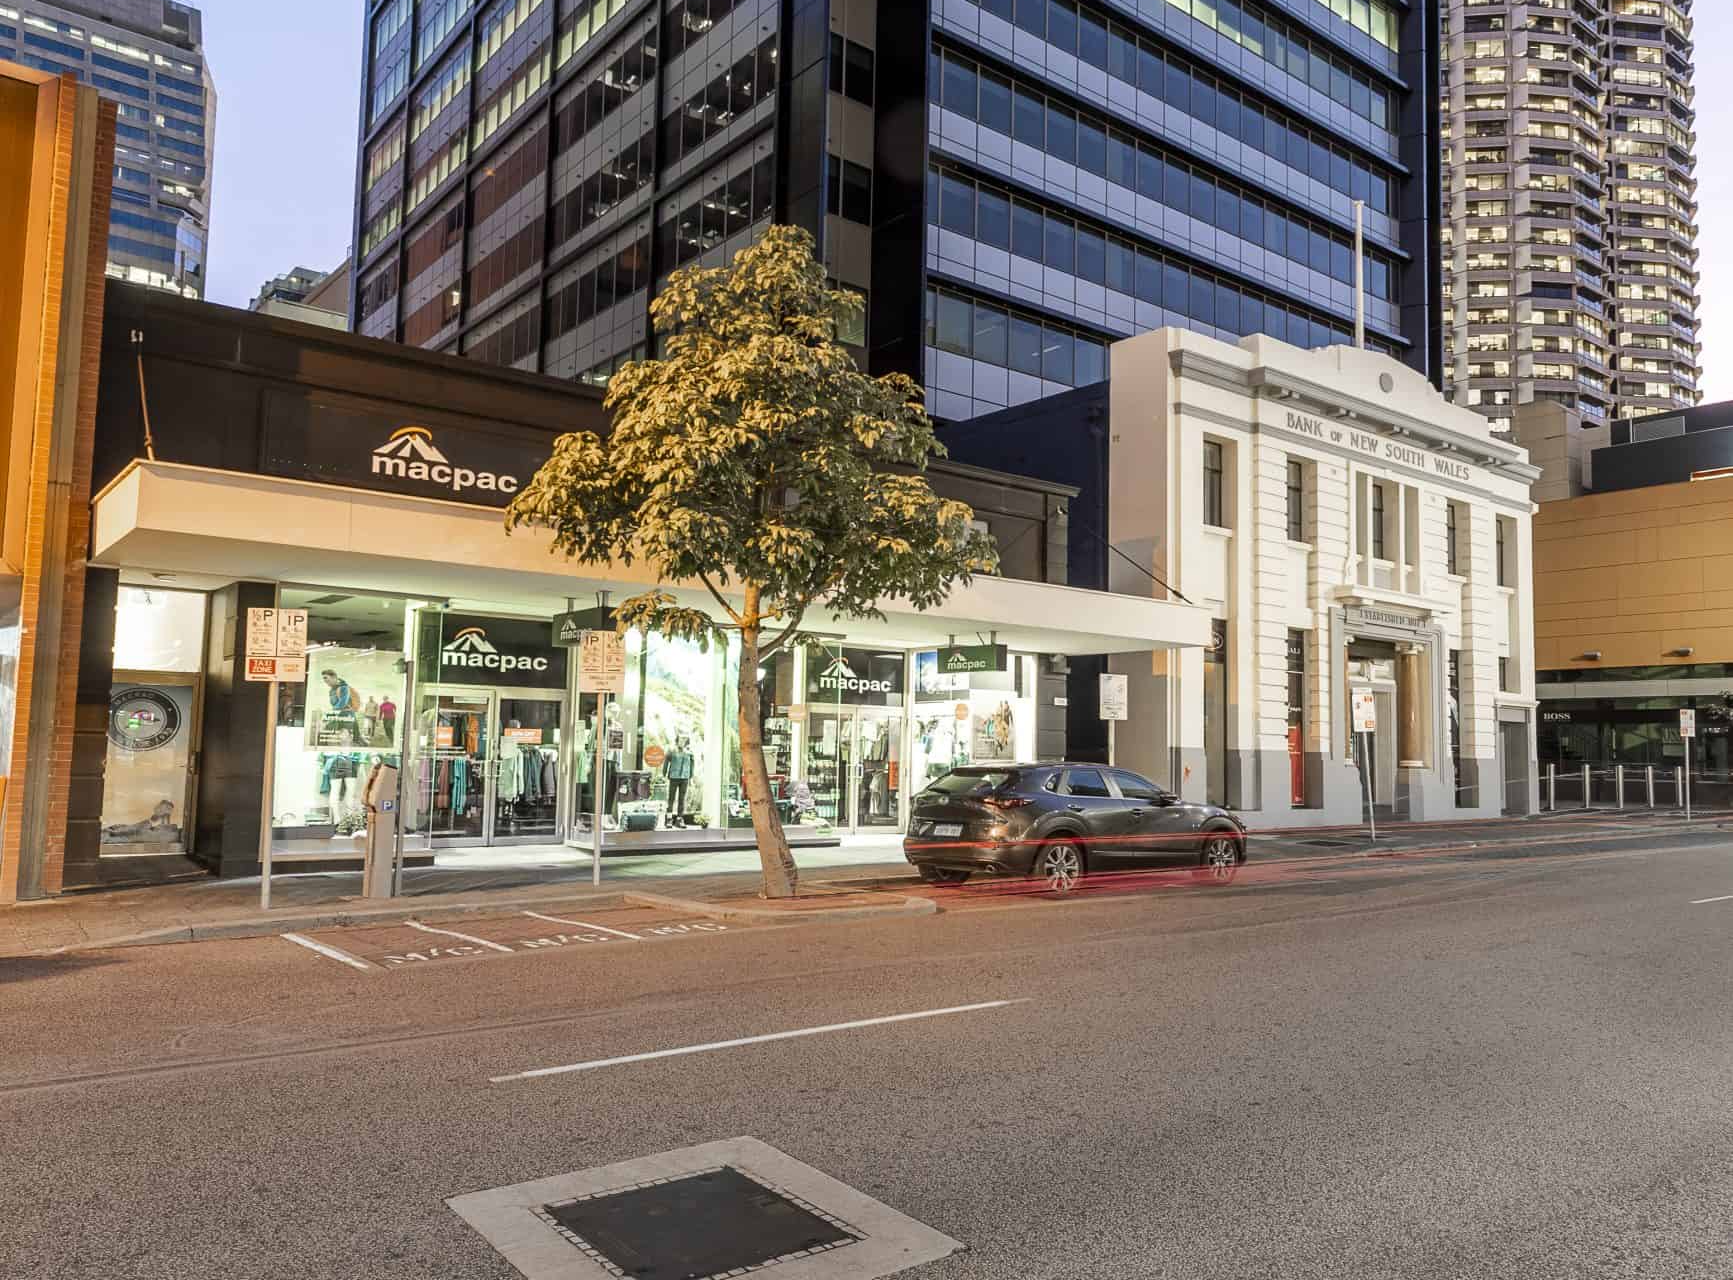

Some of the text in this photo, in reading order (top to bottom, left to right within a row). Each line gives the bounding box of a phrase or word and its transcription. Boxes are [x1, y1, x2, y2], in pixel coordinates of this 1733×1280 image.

[1286, 411, 1323, 437] BANK
[1350, 431, 1378, 453] NEW
[1385, 443, 1425, 467] SOUTH
[1434, 458, 1470, 480] WALES
[371, 455, 518, 493] macpac
[442, 651, 548, 673] macpac
[947, 661, 986, 671] macpac
[820, 676, 892, 694] macpac
[1543, 712, 1571, 720] BOSS
[383, 801, 392, 810] P
